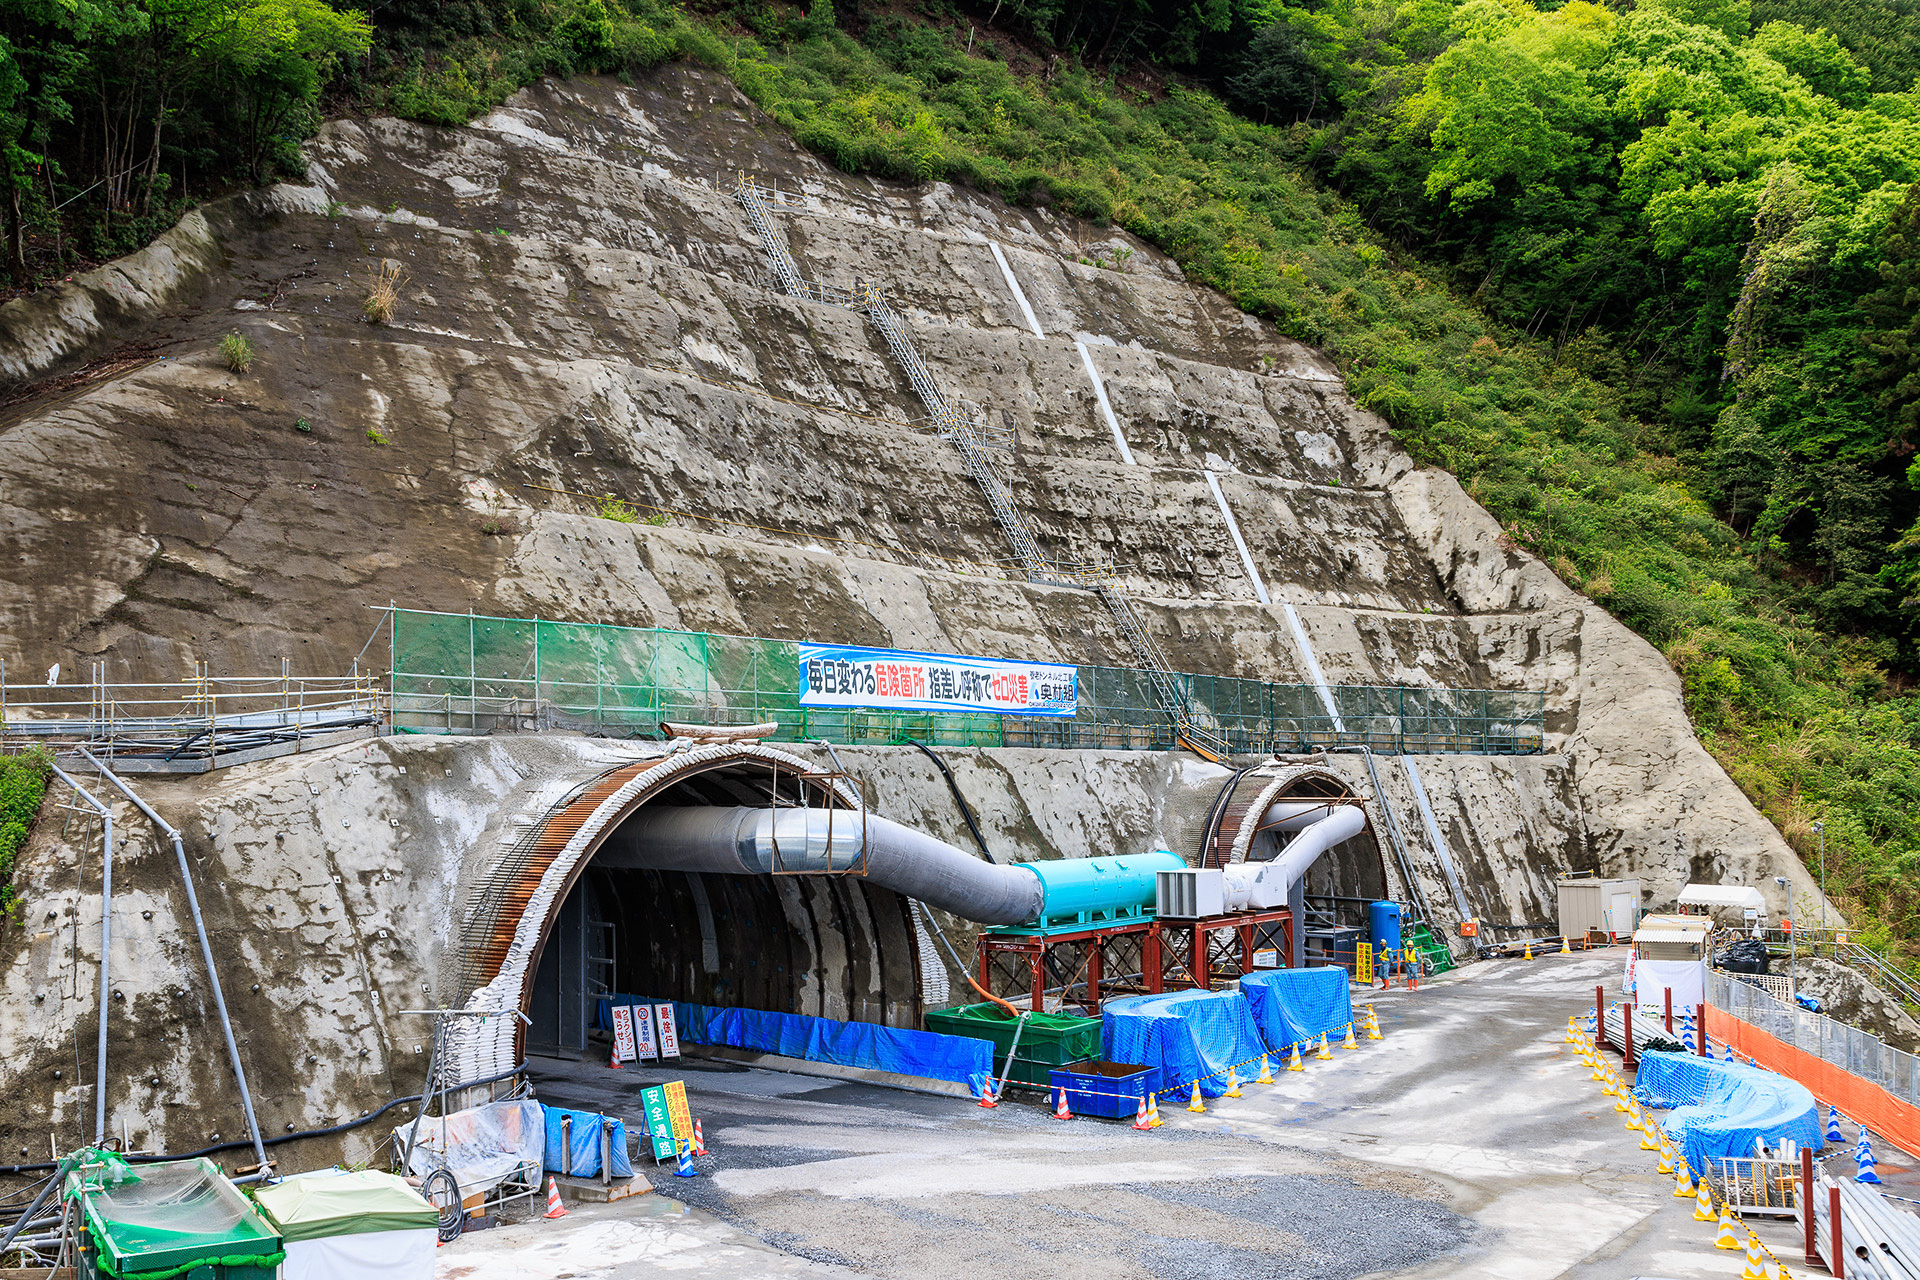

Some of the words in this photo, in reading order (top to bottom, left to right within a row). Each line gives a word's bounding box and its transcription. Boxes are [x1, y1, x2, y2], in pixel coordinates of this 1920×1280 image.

[808, 658, 926, 699] 毎日変わる危険箇所
[929, 667, 1029, 704] 指差し呼称でゼロ災害
[1040, 683, 1075, 702] 奥村組
[621, 1009, 633, 1050] クラクション
[639, 1042, 649, 1052] 20
[640, 1020, 650, 1042] 速度制限
[660, 1006, 674, 1048] 最徐行
[647, 1089, 673, 1157] 安全通路
